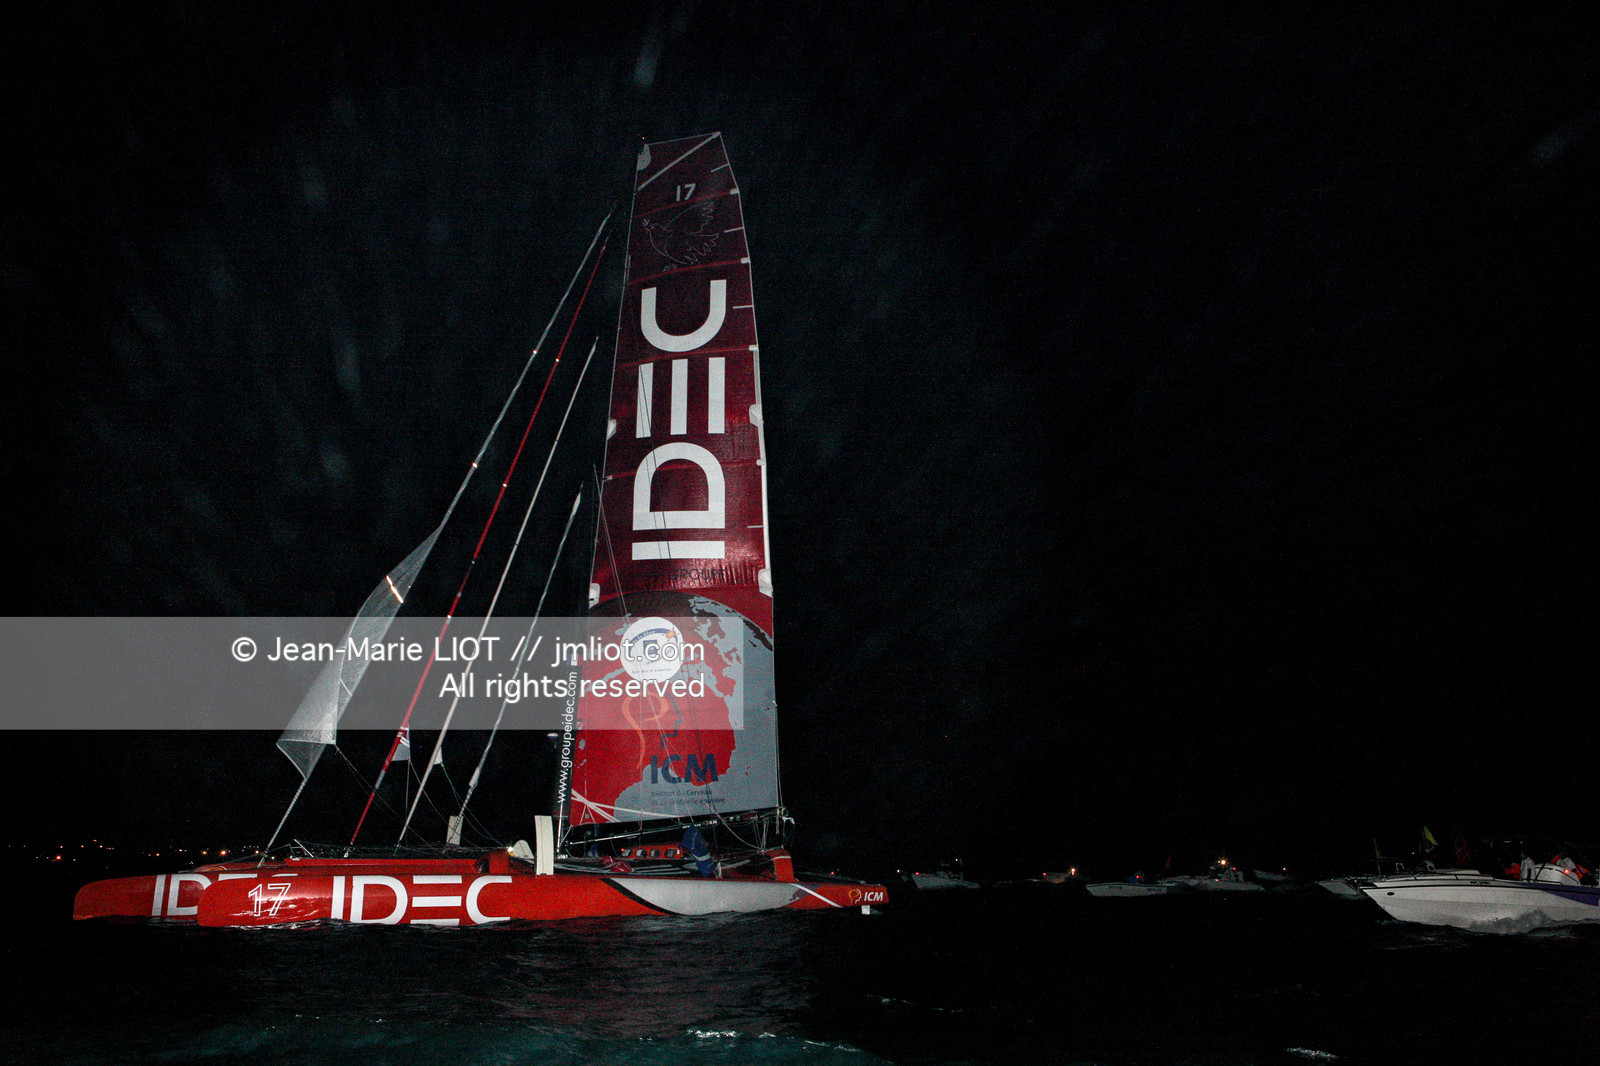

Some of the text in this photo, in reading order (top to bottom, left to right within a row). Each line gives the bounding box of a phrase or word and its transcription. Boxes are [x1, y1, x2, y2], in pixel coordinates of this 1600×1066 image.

[675, 183, 697, 202] 17
[632, 279, 727, 561] IDEC
[557, 671, 577, 804] www.groupeidec.com
[651, 753, 719, 785] ICM
[248, 883, 292, 918] 17
[330, 874, 513, 927] IDEC
[863, 891, 884, 902] ICM
